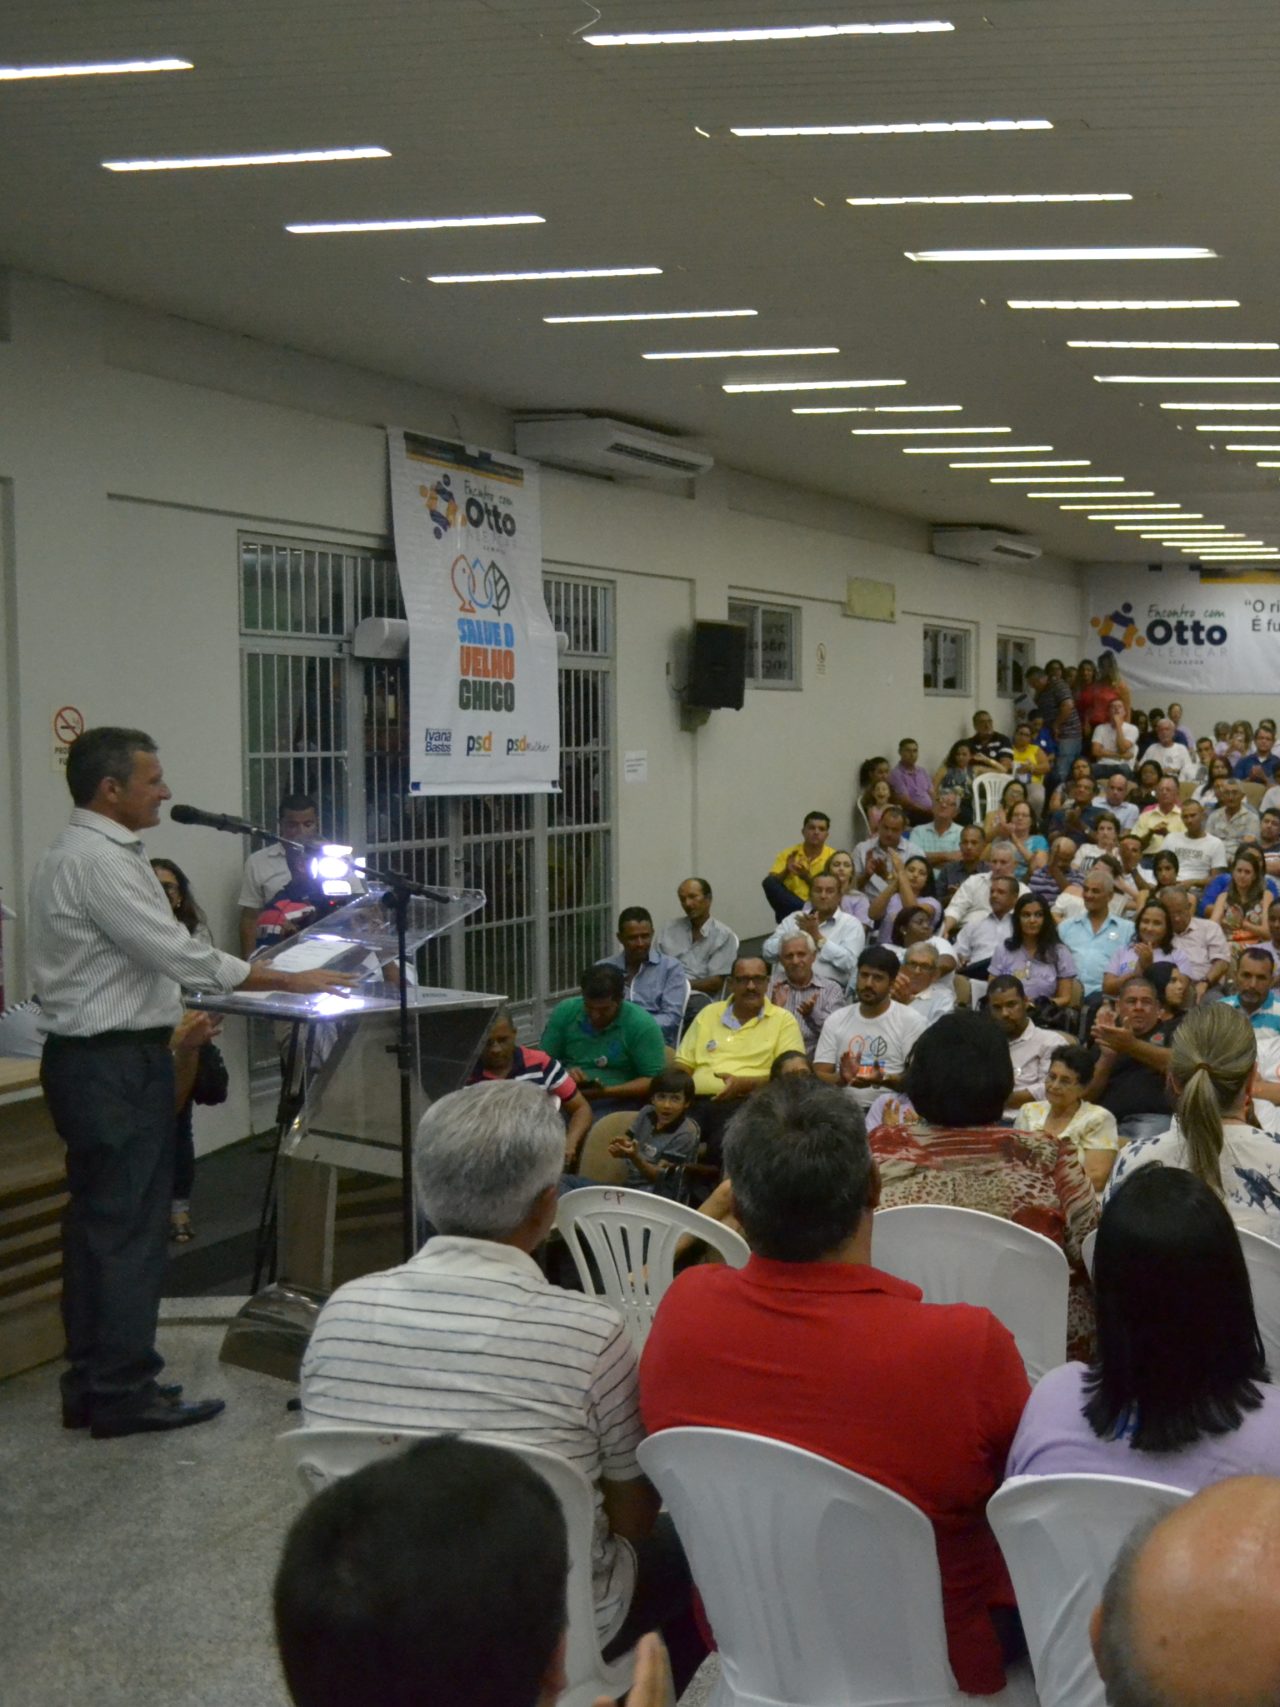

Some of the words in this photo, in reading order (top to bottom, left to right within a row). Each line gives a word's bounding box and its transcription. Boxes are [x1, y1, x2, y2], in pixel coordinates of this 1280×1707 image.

[466, 497, 516, 537] Otto
[1148, 604, 1196, 618] Encontro
[1204, 610, 1226, 618] com
[1251, 615, 1262, 632] É
[458, 618, 502, 647] SALVE
[503, 623, 515, 648] O
[1146, 619, 1228, 646] Otto
[460, 645, 516, 680] VELHO
[459, 678, 516, 712] CHICO
[425, 728, 452, 741] Ivana
[425, 741, 452, 752] Bastos
[466, 731, 493, 757] psd
